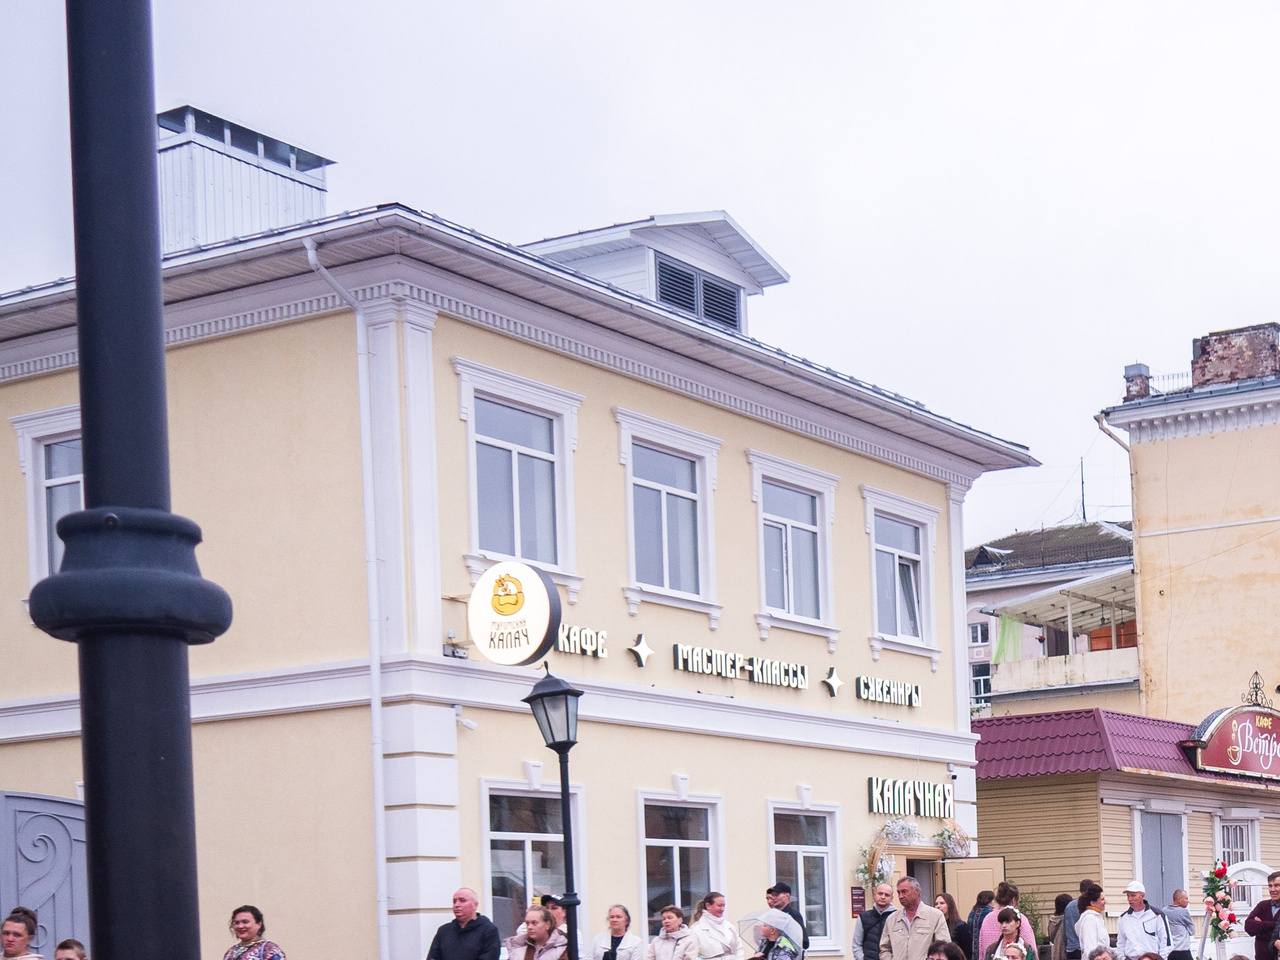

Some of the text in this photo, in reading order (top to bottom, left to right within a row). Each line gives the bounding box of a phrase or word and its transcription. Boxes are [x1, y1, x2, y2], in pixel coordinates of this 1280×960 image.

[489, 628, 529, 649] КАЛАЧ
[557, 623, 922, 707] КАФЕ МАСТЕР-КЛАССЫ СУВЕНИРЫ
[1255, 715, 1272, 730] КАФЕ
[867, 776, 954, 819] КАЛАЧНАЯ
